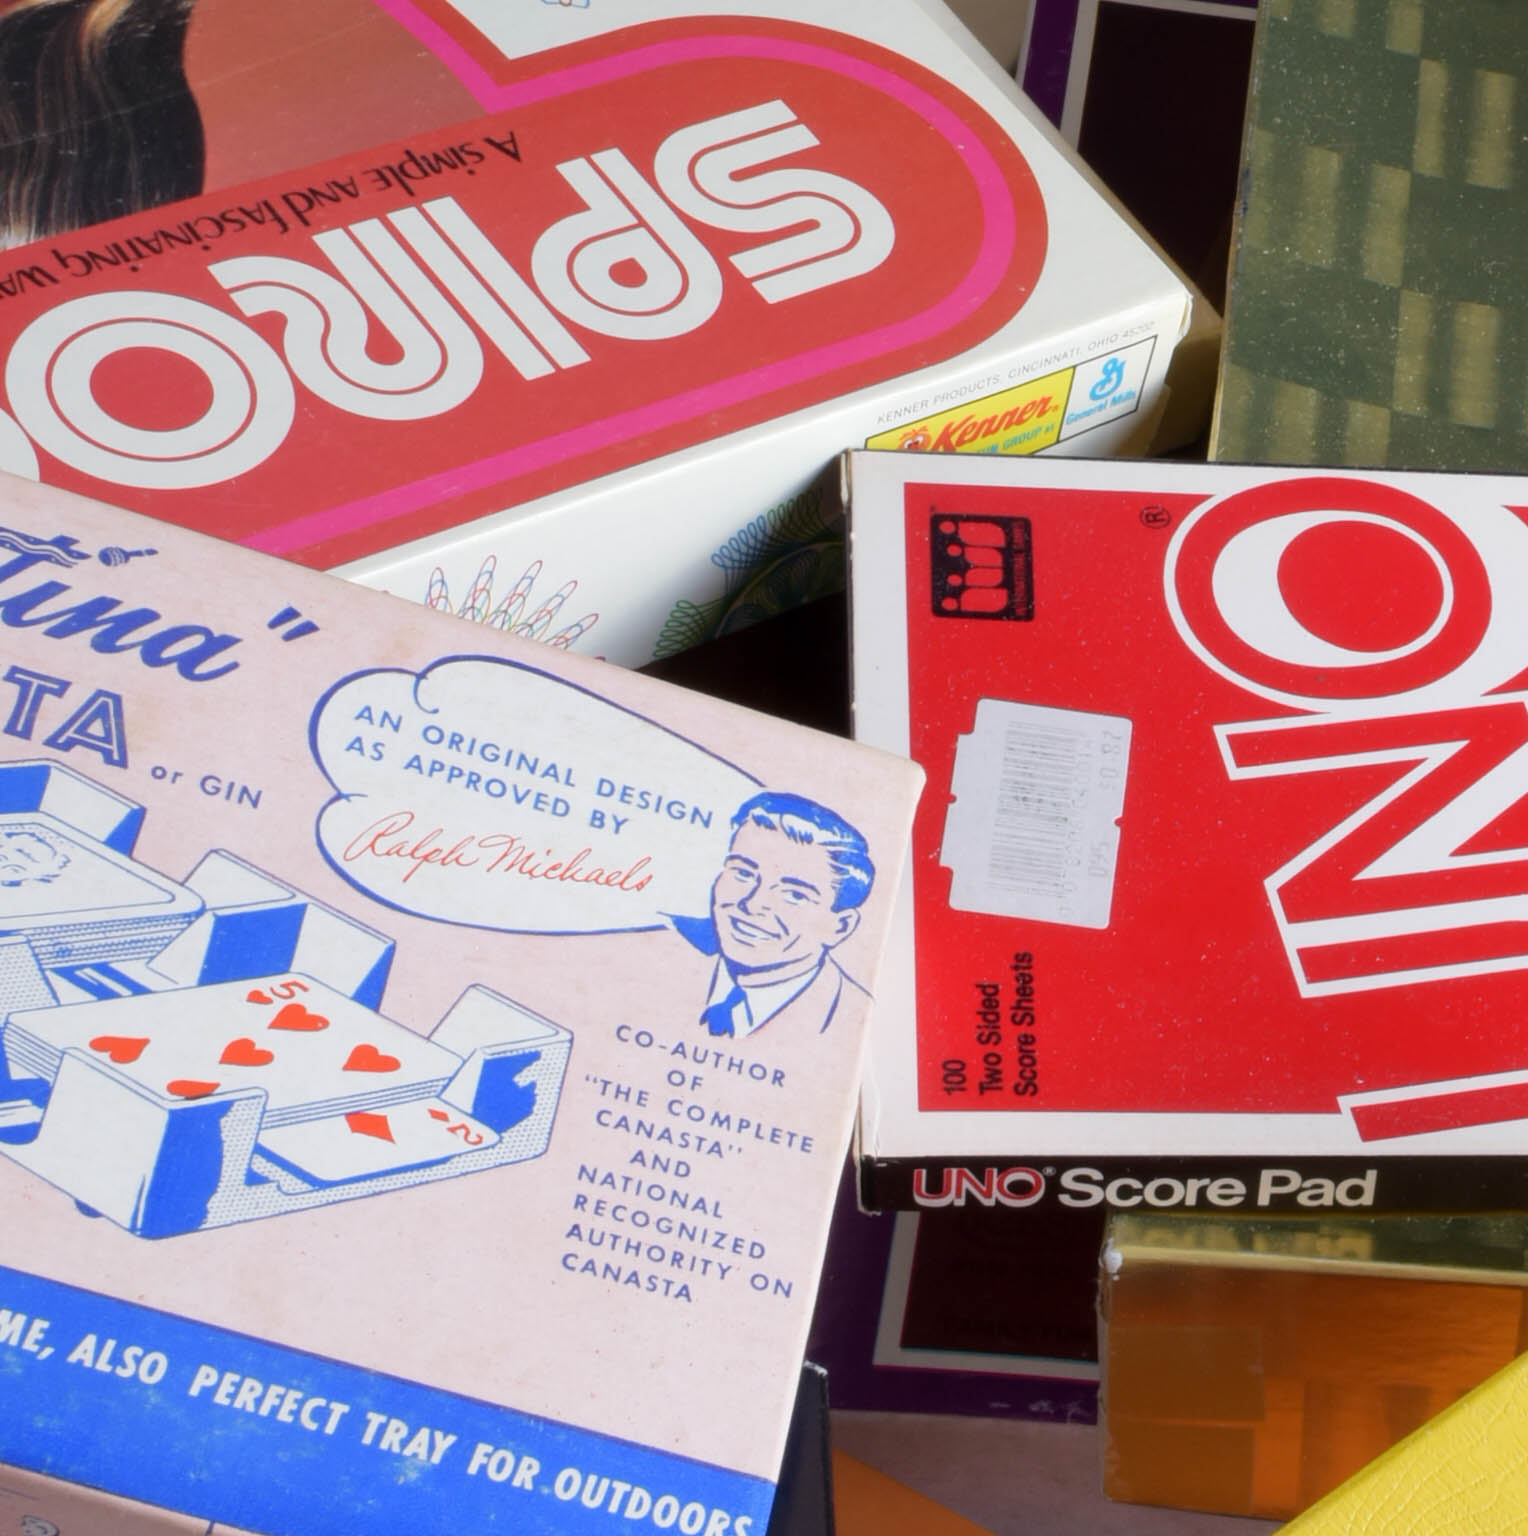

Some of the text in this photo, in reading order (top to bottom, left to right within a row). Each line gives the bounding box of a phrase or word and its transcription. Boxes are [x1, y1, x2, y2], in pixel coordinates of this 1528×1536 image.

[0, 98, 897, 490] SPIRO
[877, 399, 930, 425] KENNER
[151, 764, 184, 785] or
[199, 774, 264, 810] GIN
[345, 735, 632, 836] AS APPROVED BY
[354, 704, 714, 830] AN ORIGINAL DESIGN
[343, 810, 654, 894] Ralph Michaels
[615, 1024, 788, 1088] CO-AUTHOR
[976, 982, 1003, 1097] Two Sided
[1011, 950, 1039, 1098] Score Sheets
[666, 1069, 705, 1092] OF
[943, 1059, 968, 1096] 100
[667, 1098, 816, 1154] COMPLETE
[577, 1164, 724, 1220] NATIONAL
[629, 1149, 692, 1179] AND
[1057, 1166, 1247, 1208] Score
[1256, 1168, 1379, 1208] Pad
[573, 1193, 767, 1260] RECOGNIZED
[561, 1252, 694, 1304] CANASTA
[565, 1223, 794, 1300] AUTHORITY ON
[66, 1332, 169, 1385] ALSO
[187, 1365, 351, 1437] PERFECT
[360, 1412, 457, 1466] TRAY
[467, 1443, 542, 1493] FOR
